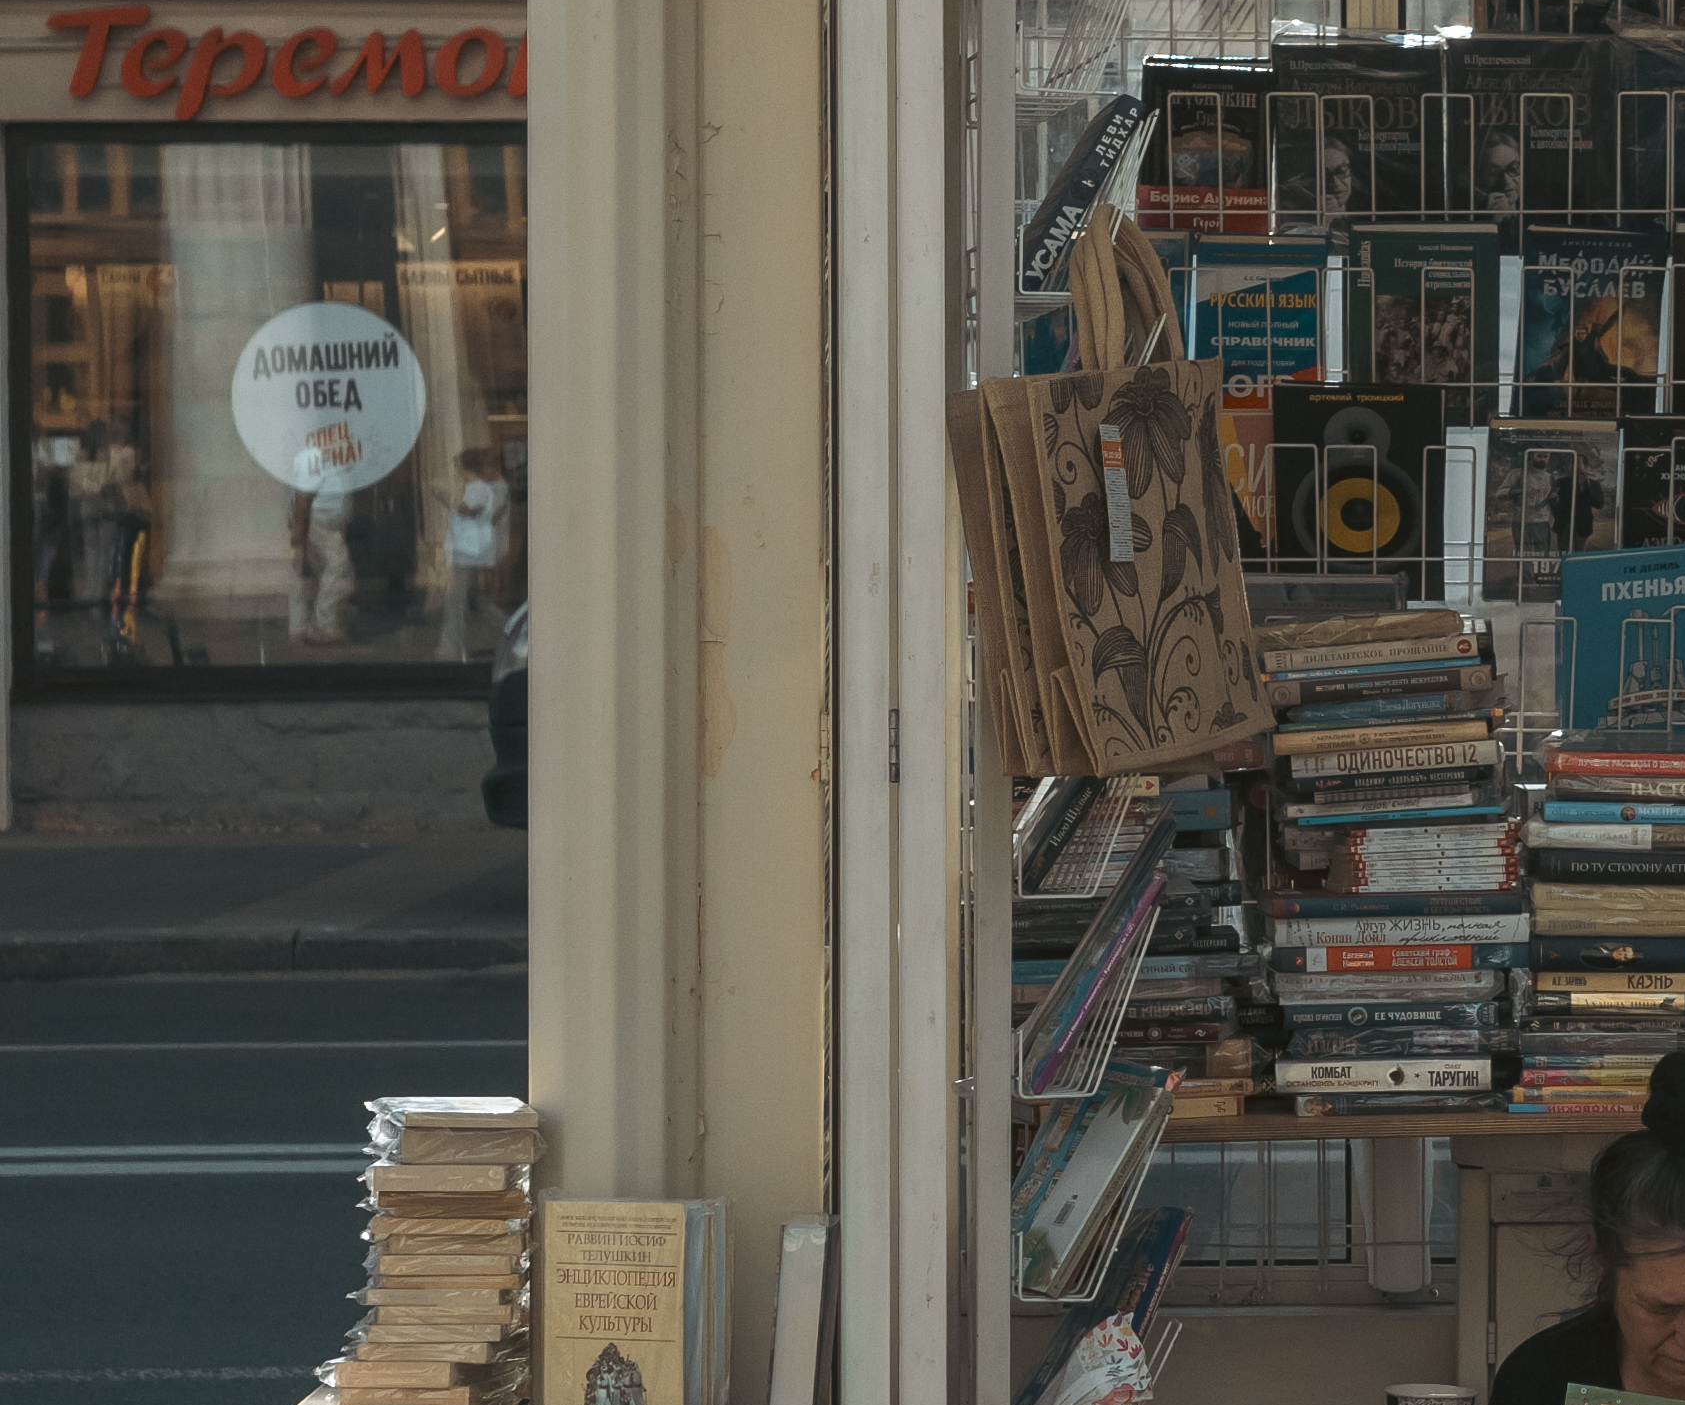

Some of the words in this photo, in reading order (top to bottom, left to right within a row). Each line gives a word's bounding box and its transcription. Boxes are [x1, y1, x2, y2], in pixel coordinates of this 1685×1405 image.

[46, 5, 528, 120] Теремо
[1095, 113, 1124, 156] ЛЕВИ
[1099, 107, 1140, 169] ТИДХАР
[1025, 206, 1084, 281] УСАМА
[1209, 289, 1275, 309] РУССКИЙ
[1278, 293, 1317, 309] ЯЗЫК
[1210, 336, 1316, 348] СПРАВОЧНИК
[252, 332, 399, 381] ДОМАШНИЙ
[295, 378, 362, 412] ОБЕД
[1336, 745, 1456, 773] ОДИНОЧЕСТВО
[1571, 861, 1589, 873] ПО
[1590, 862, 1606, 874] ТУ
[1607, 862, 1663, 874] СТОРОНУ
[1316, 931, 1352, 944] Конан
[1355, 929, 1387, 945] Дойл
[1355, 919, 1386, 935] Артур
[1389, 919, 1446, 934] ЖИЗНЬ,
[1627, 974, 1673, 990] КАЗНЬ
[1374, 1012, 1387, 1021] ЕЕ
[1388, 1010, 1442, 1021] ЧУДОВИЩЕ
[1311, 1065, 1352, 1080] КОМБАТ
[1427, 1069, 1480, 1087] ТАРУГИН
[567, 1233, 616, 1246] РАВВИН
[619, 1234, 666, 1248] ИОСИФ
[580, 1250, 652, 1264] ТЕЛУШКИН
[556, 1268, 677, 1289] ЭНЦИКЛОПЕДИЯ
[573, 1291, 658, 1311] ЕВРЕЙСКОЙ
[578, 1314, 653, 1335] КУЛЬТУРЫ
